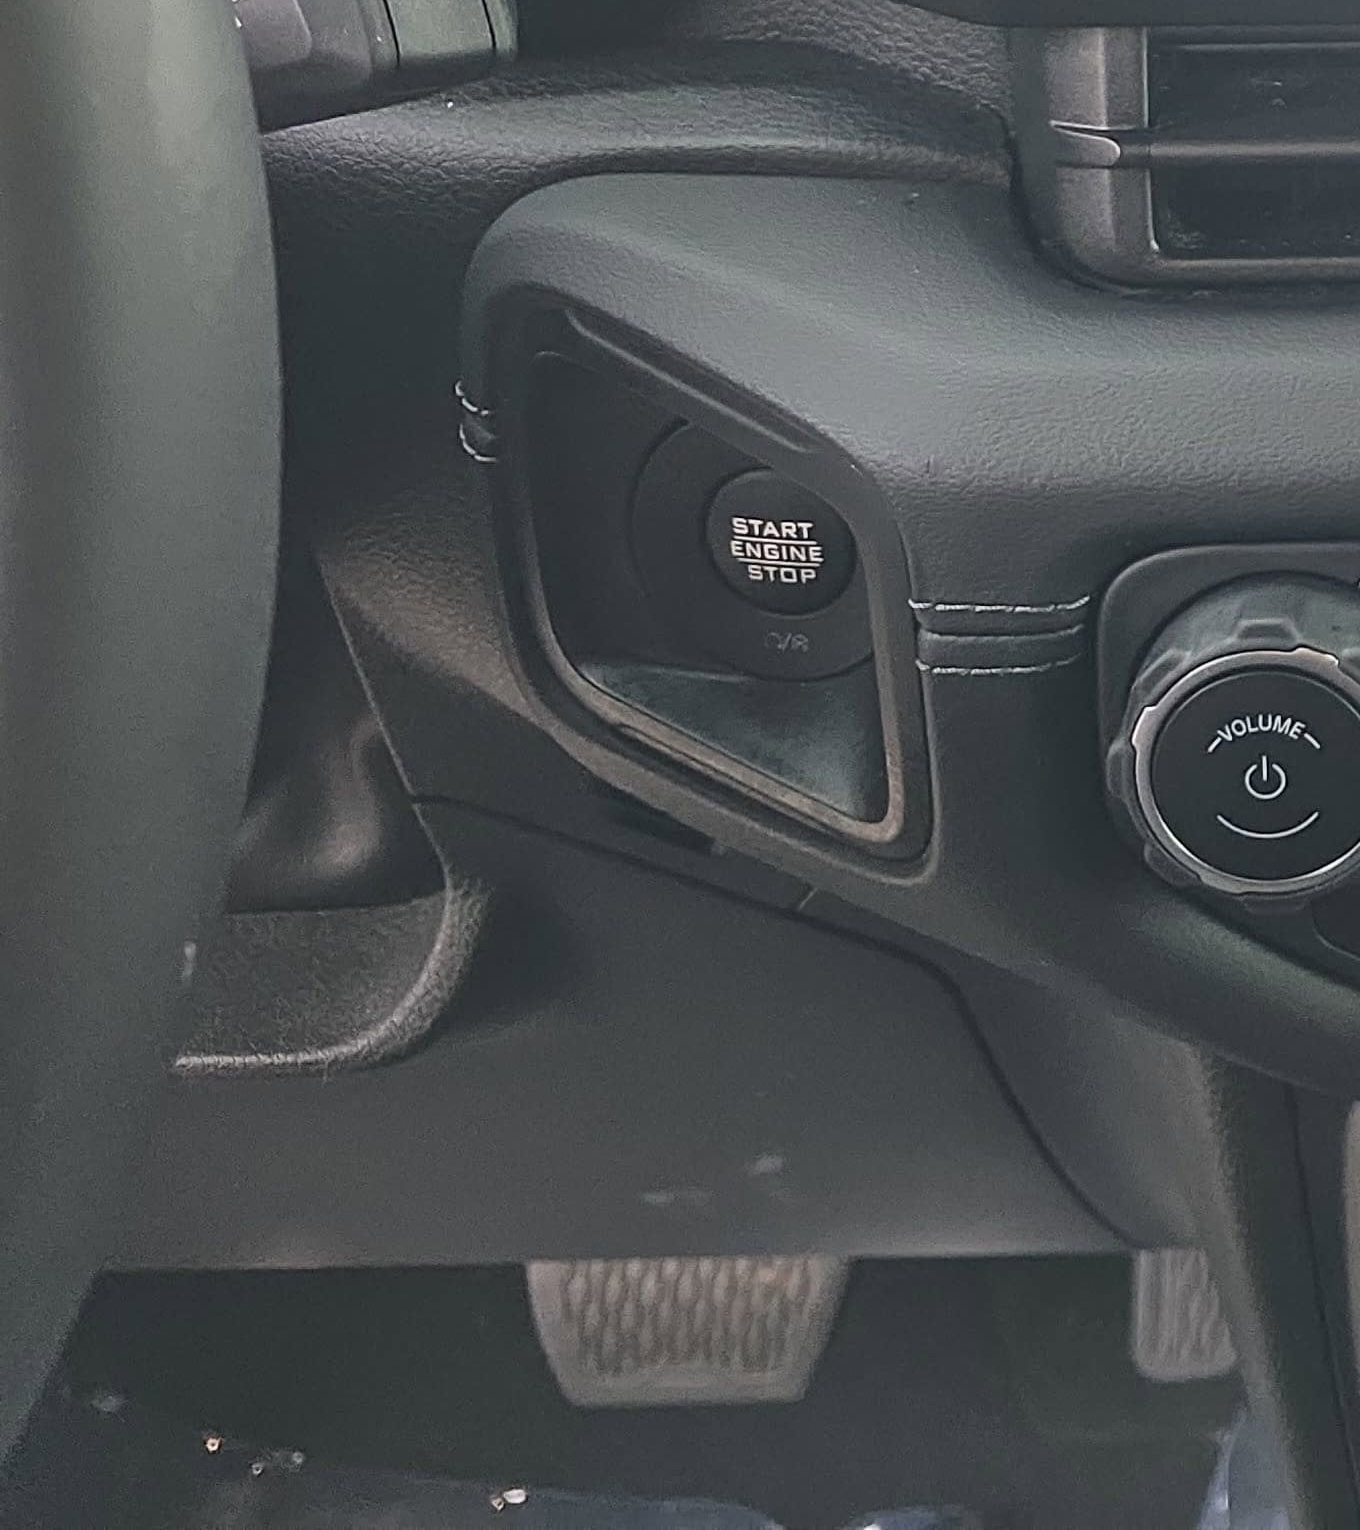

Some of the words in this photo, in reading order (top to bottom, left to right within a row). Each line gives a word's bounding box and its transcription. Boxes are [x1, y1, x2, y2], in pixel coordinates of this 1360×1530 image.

[732, 517, 813, 540] START
[730, 540, 824, 563] ENGINE
[747, 565, 817, 584] STOP
[1217, 714, 1306, 743] VOLUME
